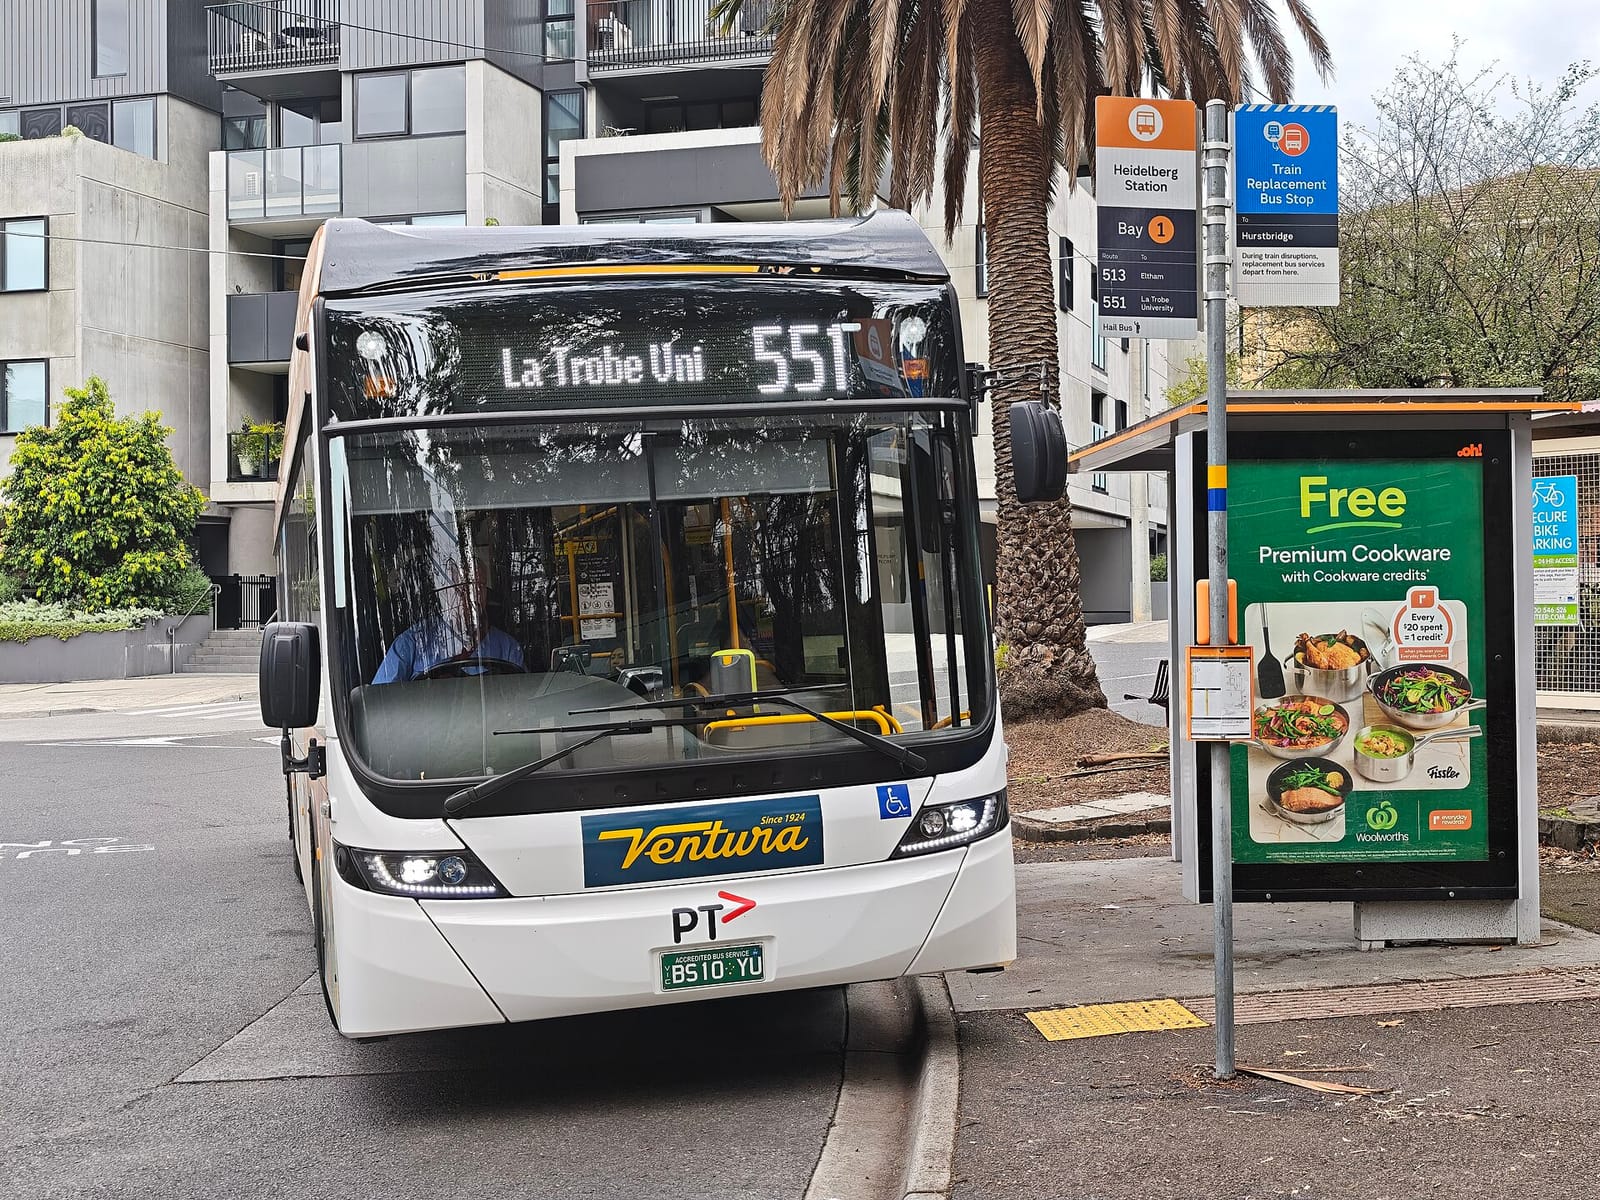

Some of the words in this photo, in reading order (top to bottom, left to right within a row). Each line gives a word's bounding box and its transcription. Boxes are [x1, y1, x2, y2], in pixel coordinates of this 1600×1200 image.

[1113, 164, 1178, 181] Heidelberg
[1272, 164, 1302, 175] Train
[1124, 180, 1168, 193] Station
[1247, 178, 1327, 192] Replacement
[1260, 193, 1282, 204] Bus
[1285, 194, 1314, 207] Stop
[1117, 222, 1143, 238] Bay
[1156, 222, 1166, 238] 1
[1241, 231, 1294, 242] Hurstbridge
[1241, 252, 1263, 261] During
[1264, 252, 1280, 260] train
[1280, 252, 1319, 261] disruptions,
[1241, 260, 1283, 269] replacement
[1284, 260, 1297, 268] bus
[1297, 260, 1326, 268] services
[1102, 268, 1126, 282] 513
[1140, 272, 1164, 281] Eltham
[1241, 269, 1264, 277] depart
[1265, 268, 1282, 276] from
[1282, 268, 1300, 276] here.
[1102, 295, 1127, 309] 551
[1140, 295, 1150, 303] La
[1151, 295, 1170, 304] Trobe
[1140, 303, 1174, 313] University
[1103, 322, 1117, 332] Hail
[1118, 323, 1133, 333] Bus
[752, 323, 848, 393] 551
[502, 346, 544, 389] La
[550, 344, 643, 387] Trobe
[649, 343, 704, 383] Uni
[1299, 475, 1407, 518] Free
[1532, 510, 1568, 524] ECURE
[1534, 524, 1559, 537] BIKE
[1533, 537, 1572, 549] RKING
[1259, 545, 1347, 565] Premium
[1351, 543, 1452, 563] Cookware
[1281, 569, 1310, 583] with
[1312, 569, 1380, 583] Cookware
[1411, 613, 1435, 623] Every
[1403, 623, 1419, 632] $20
[1420, 624, 1443, 633] spent
[1427, 765, 1460, 779] Fissler
[760, 814, 784, 825] Since
[784, 812, 806, 823] 1924
[1356, 832, 1409, 842] Woolworths
[598, 820, 809, 870] Ventura
[675, 954, 712, 964] ACCREDITED
[712, 952, 725, 960] BUS
[725, 950, 750, 959] SERVICE
[671, 960, 724, 984] BS10
[736, 956, 763, 977] YU
